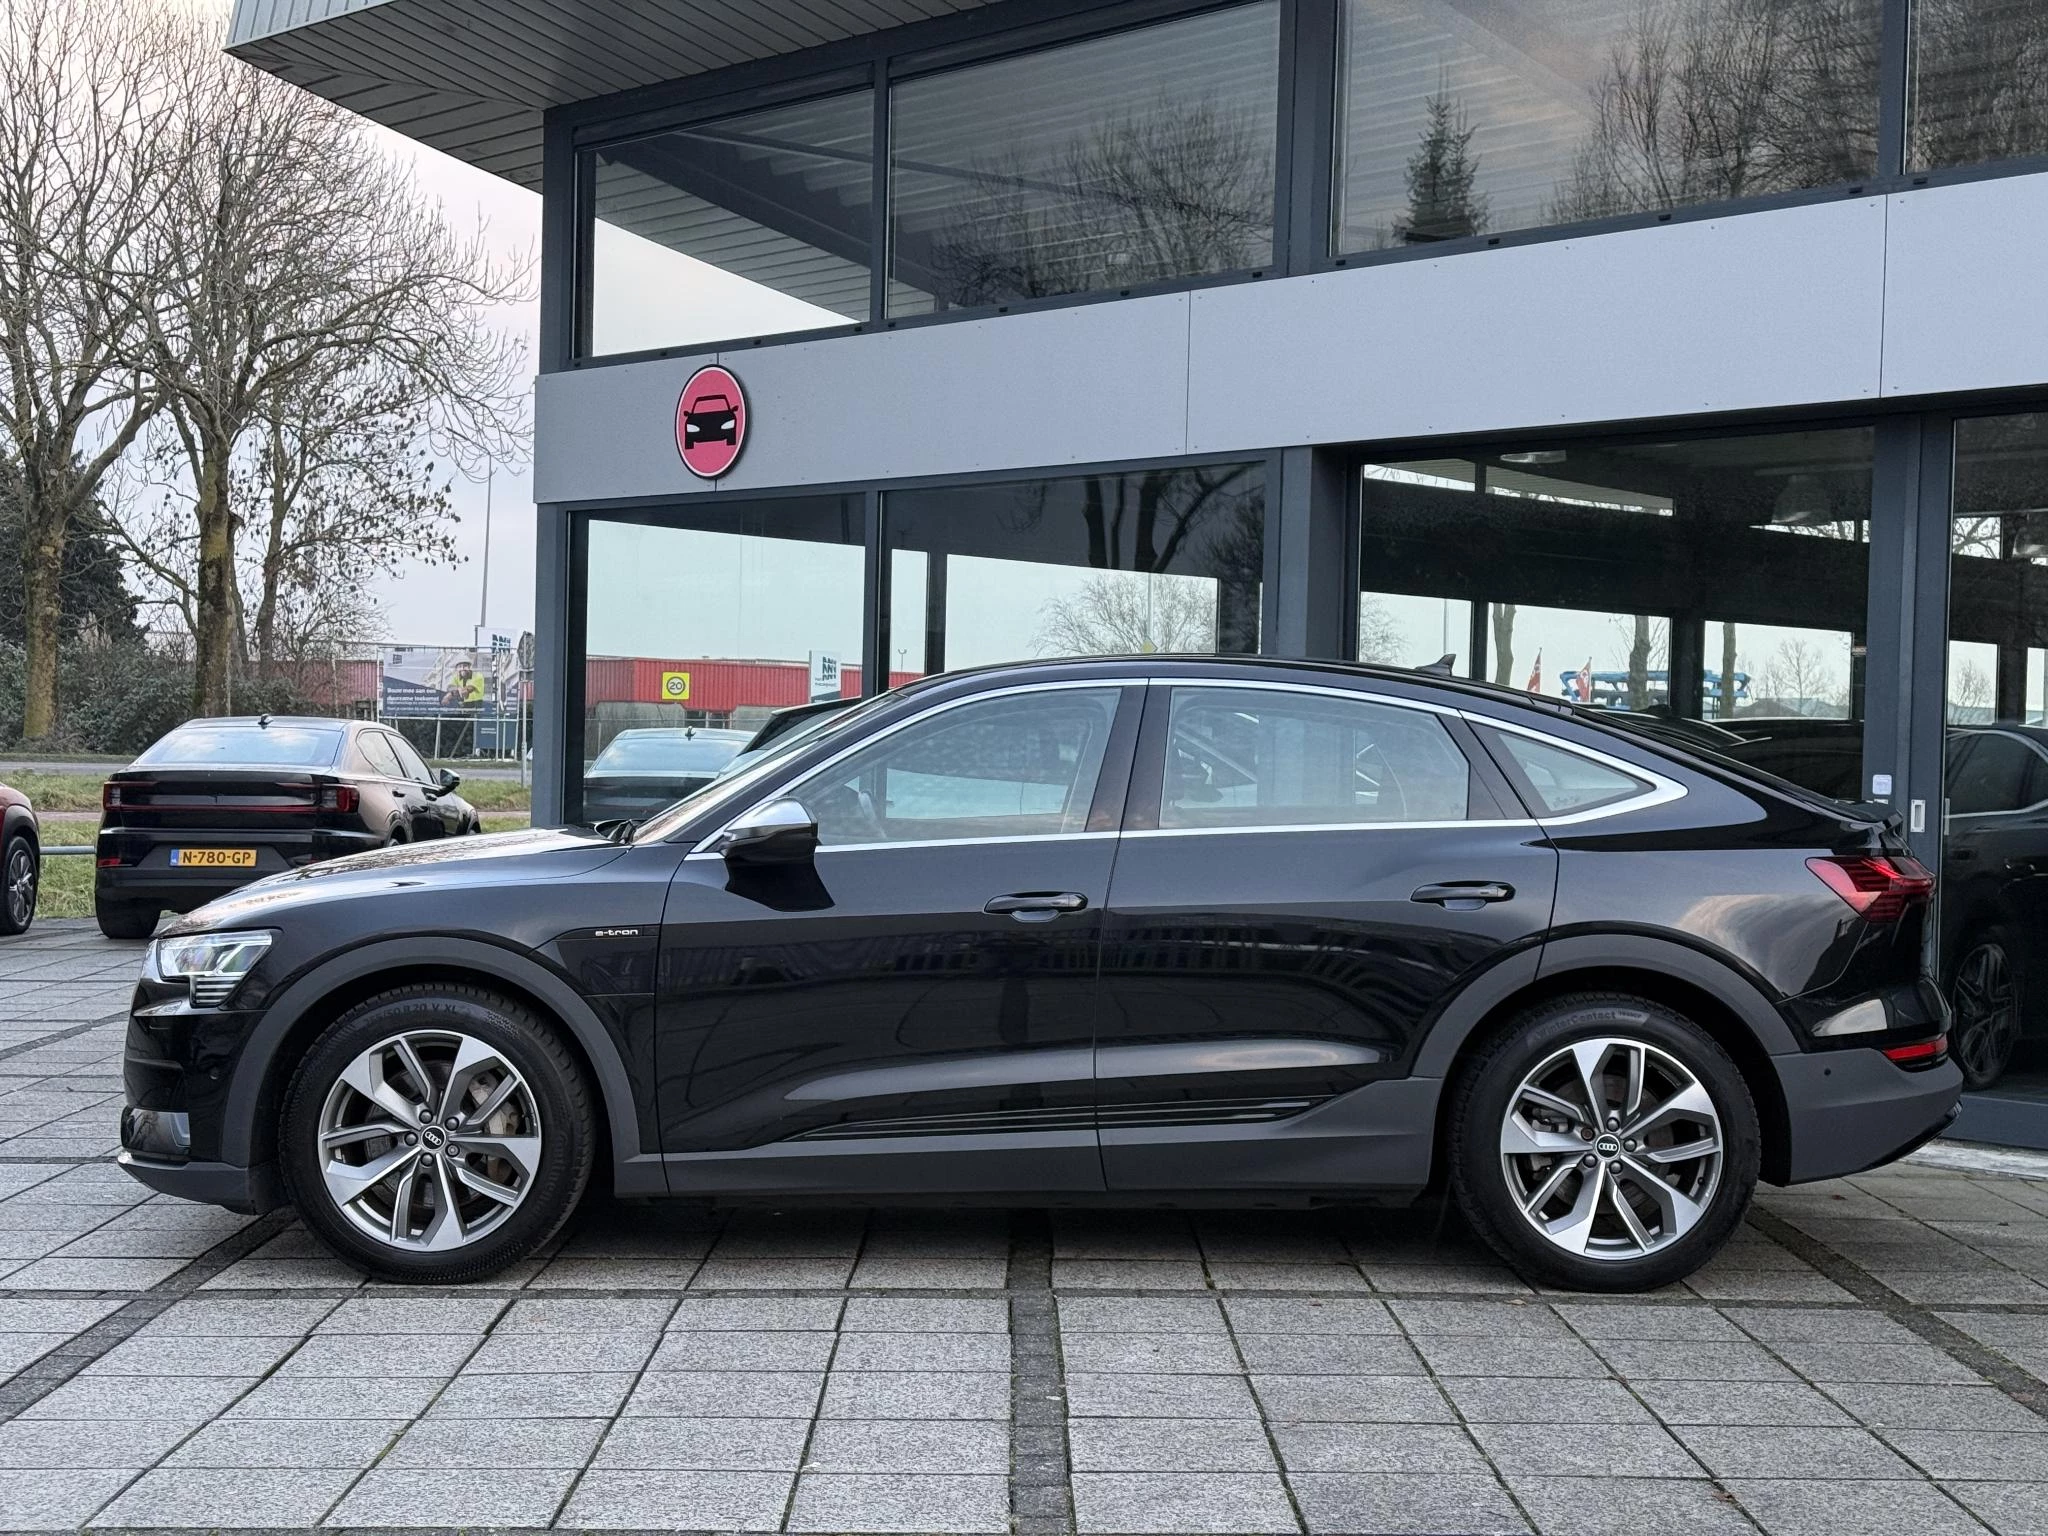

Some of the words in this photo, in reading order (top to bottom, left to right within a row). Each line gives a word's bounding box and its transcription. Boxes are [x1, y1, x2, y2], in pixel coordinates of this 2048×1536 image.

[669, 681, 683, 691] 20
[182, 851, 251, 863] N-780-GP
[594, 928, 639, 937] e-tron
